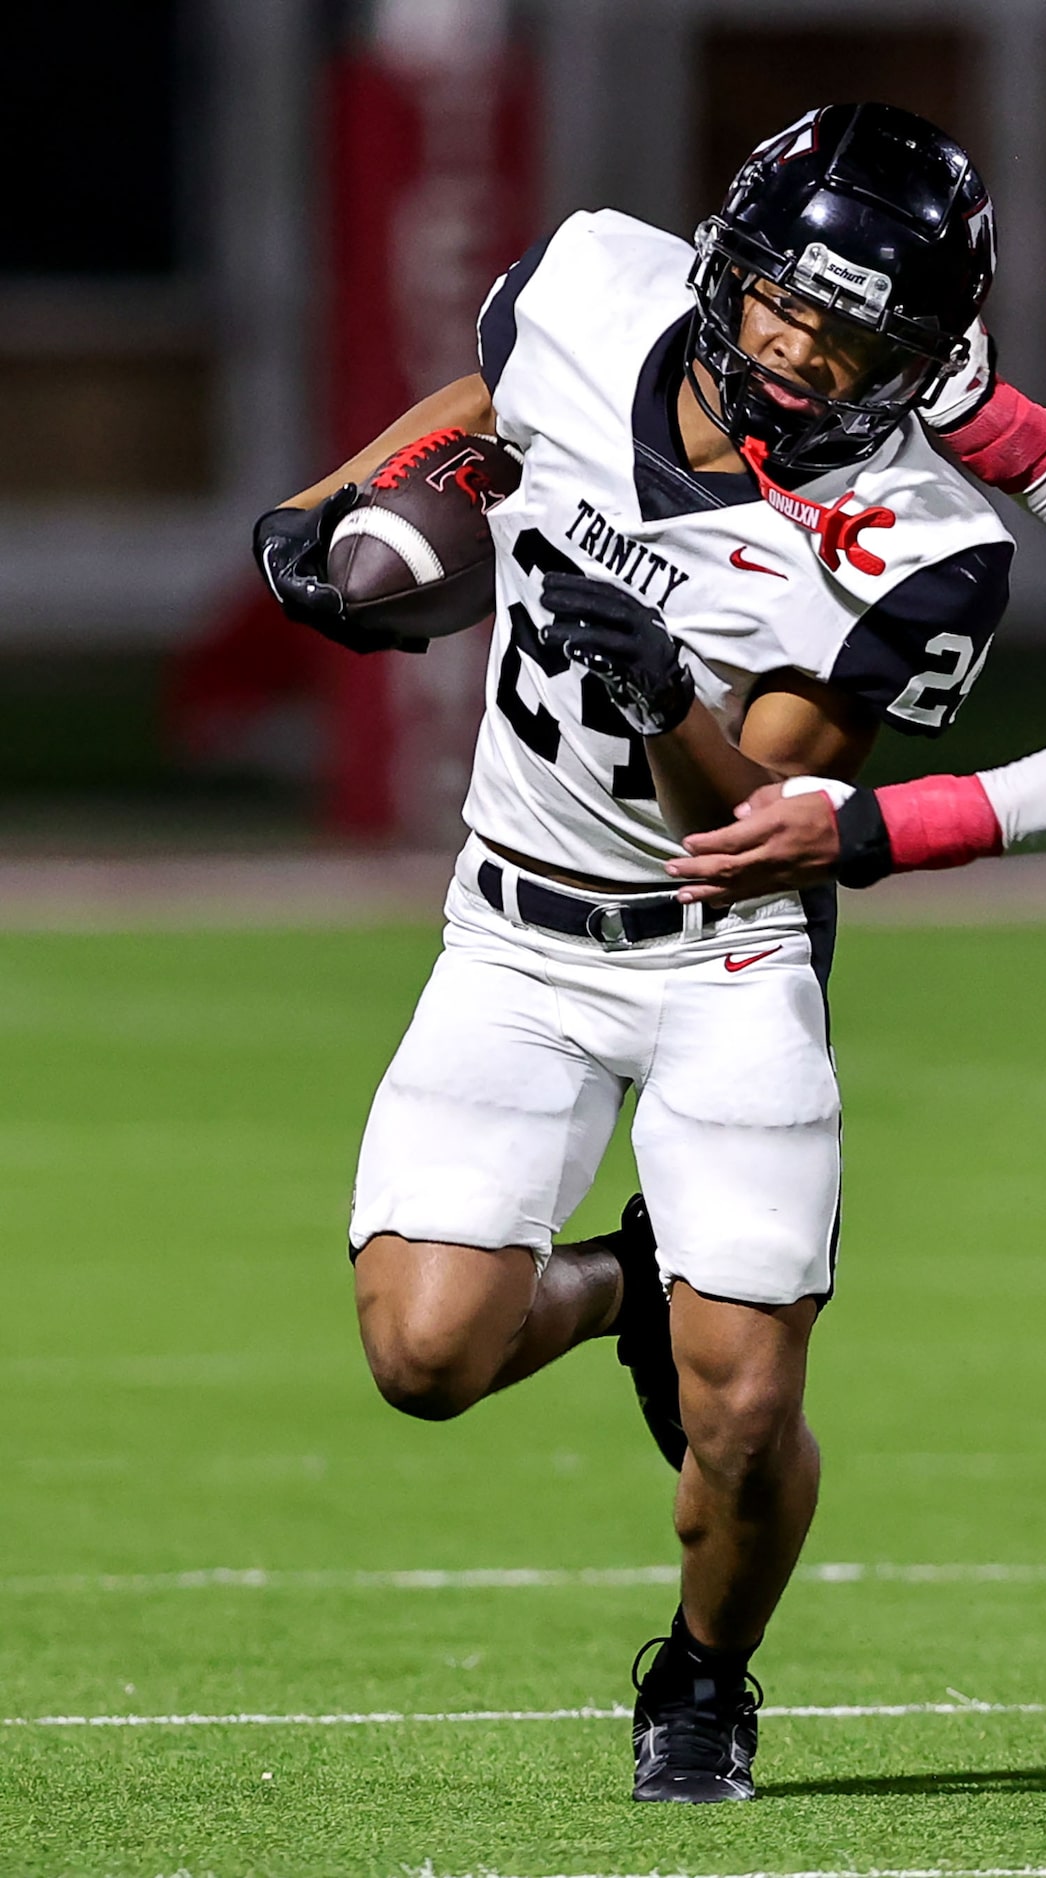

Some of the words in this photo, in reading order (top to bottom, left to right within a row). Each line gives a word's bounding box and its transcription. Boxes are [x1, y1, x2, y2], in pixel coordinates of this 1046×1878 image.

[827, 263, 868, 285] schutt
[768, 488, 820, 529] NXTRND
[565, 498, 690, 610] TRINITY
